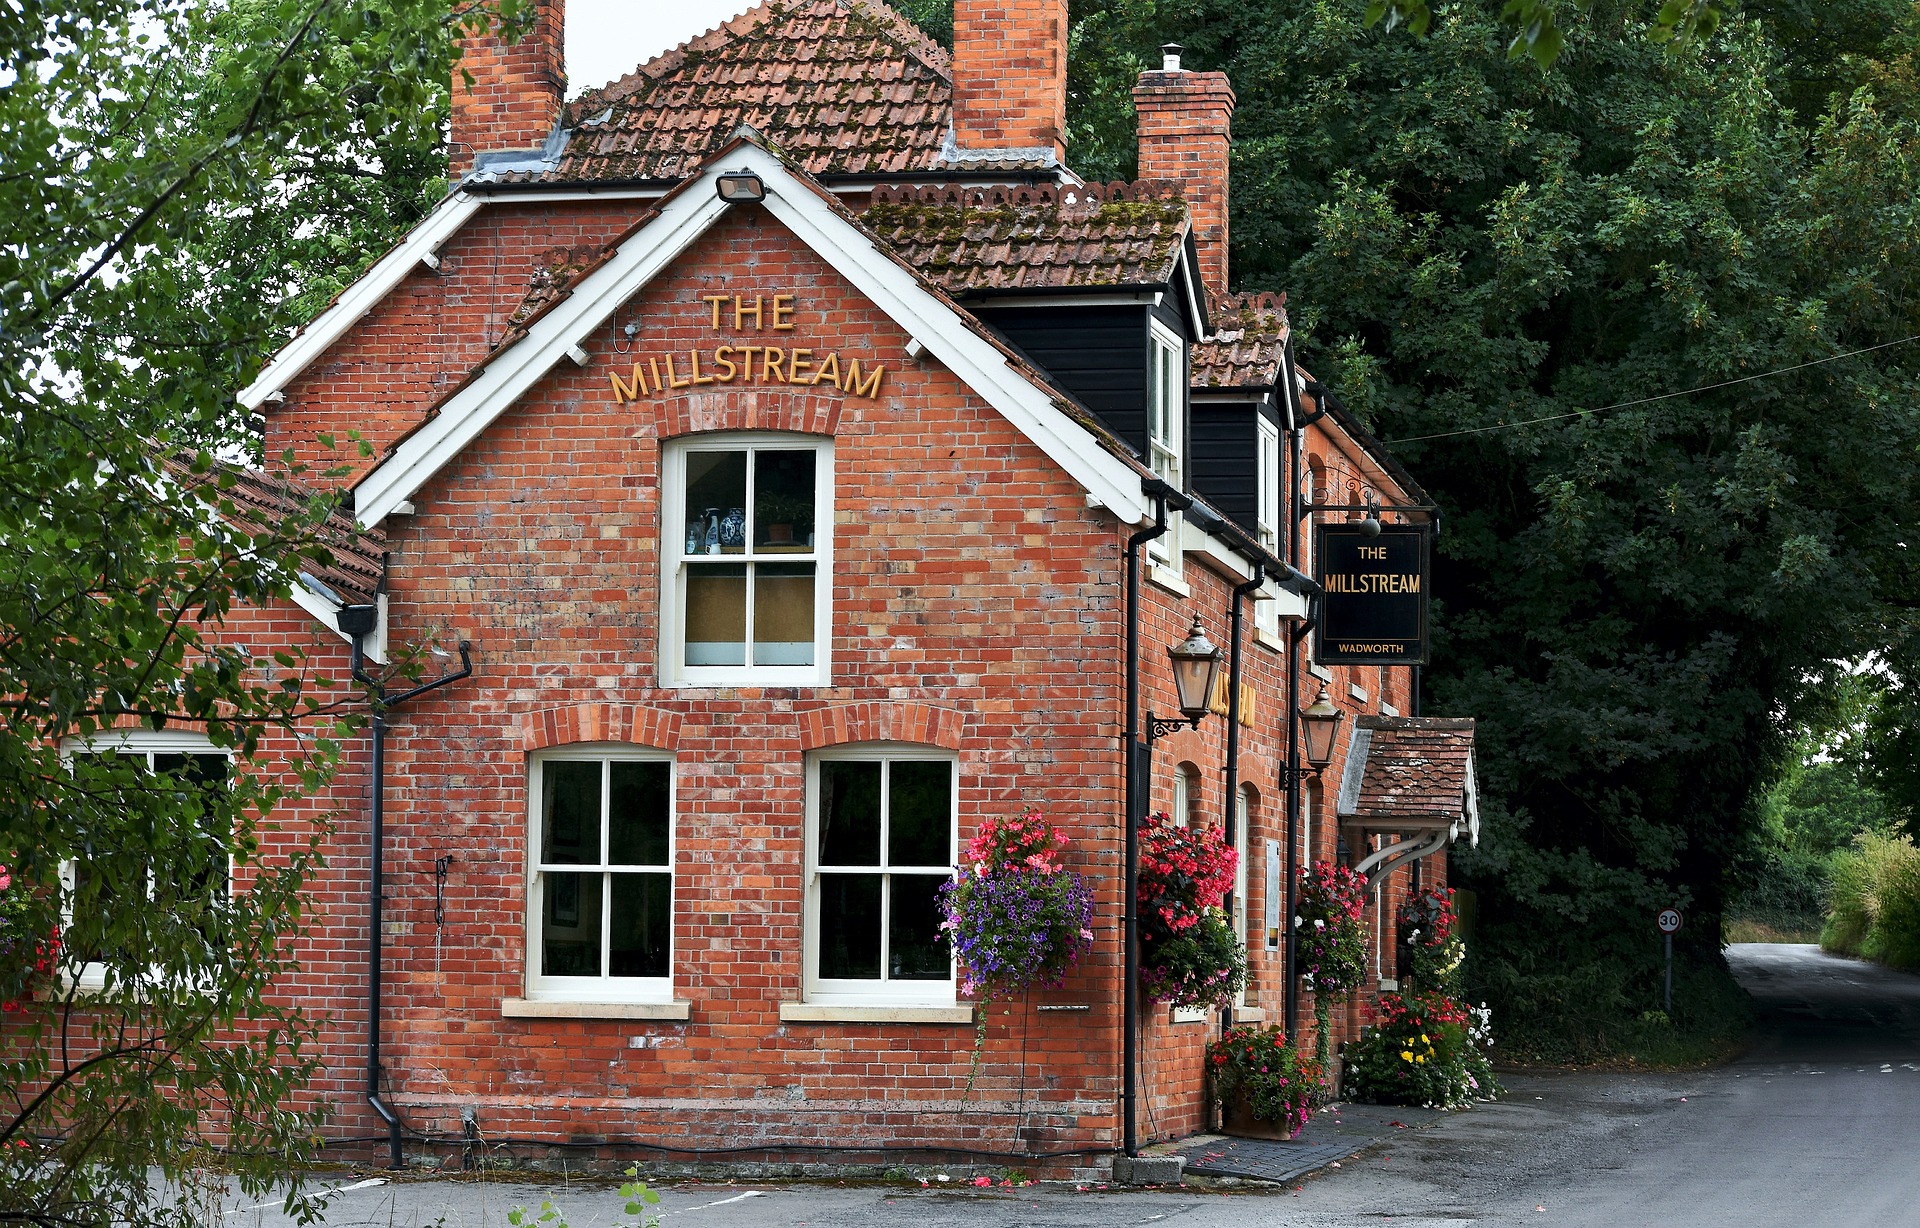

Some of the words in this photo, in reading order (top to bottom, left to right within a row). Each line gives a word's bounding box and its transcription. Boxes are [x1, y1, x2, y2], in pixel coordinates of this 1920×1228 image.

[703, 294, 795, 331] THE
[608, 345, 885, 404] MILLSTREAM
[1357, 546, 1387, 560] THE
[1324, 574, 1421, 593] MILLSTREAM
[1338, 644, 1404, 654] WADWORTH
[1660, 915, 1678, 926] 30
